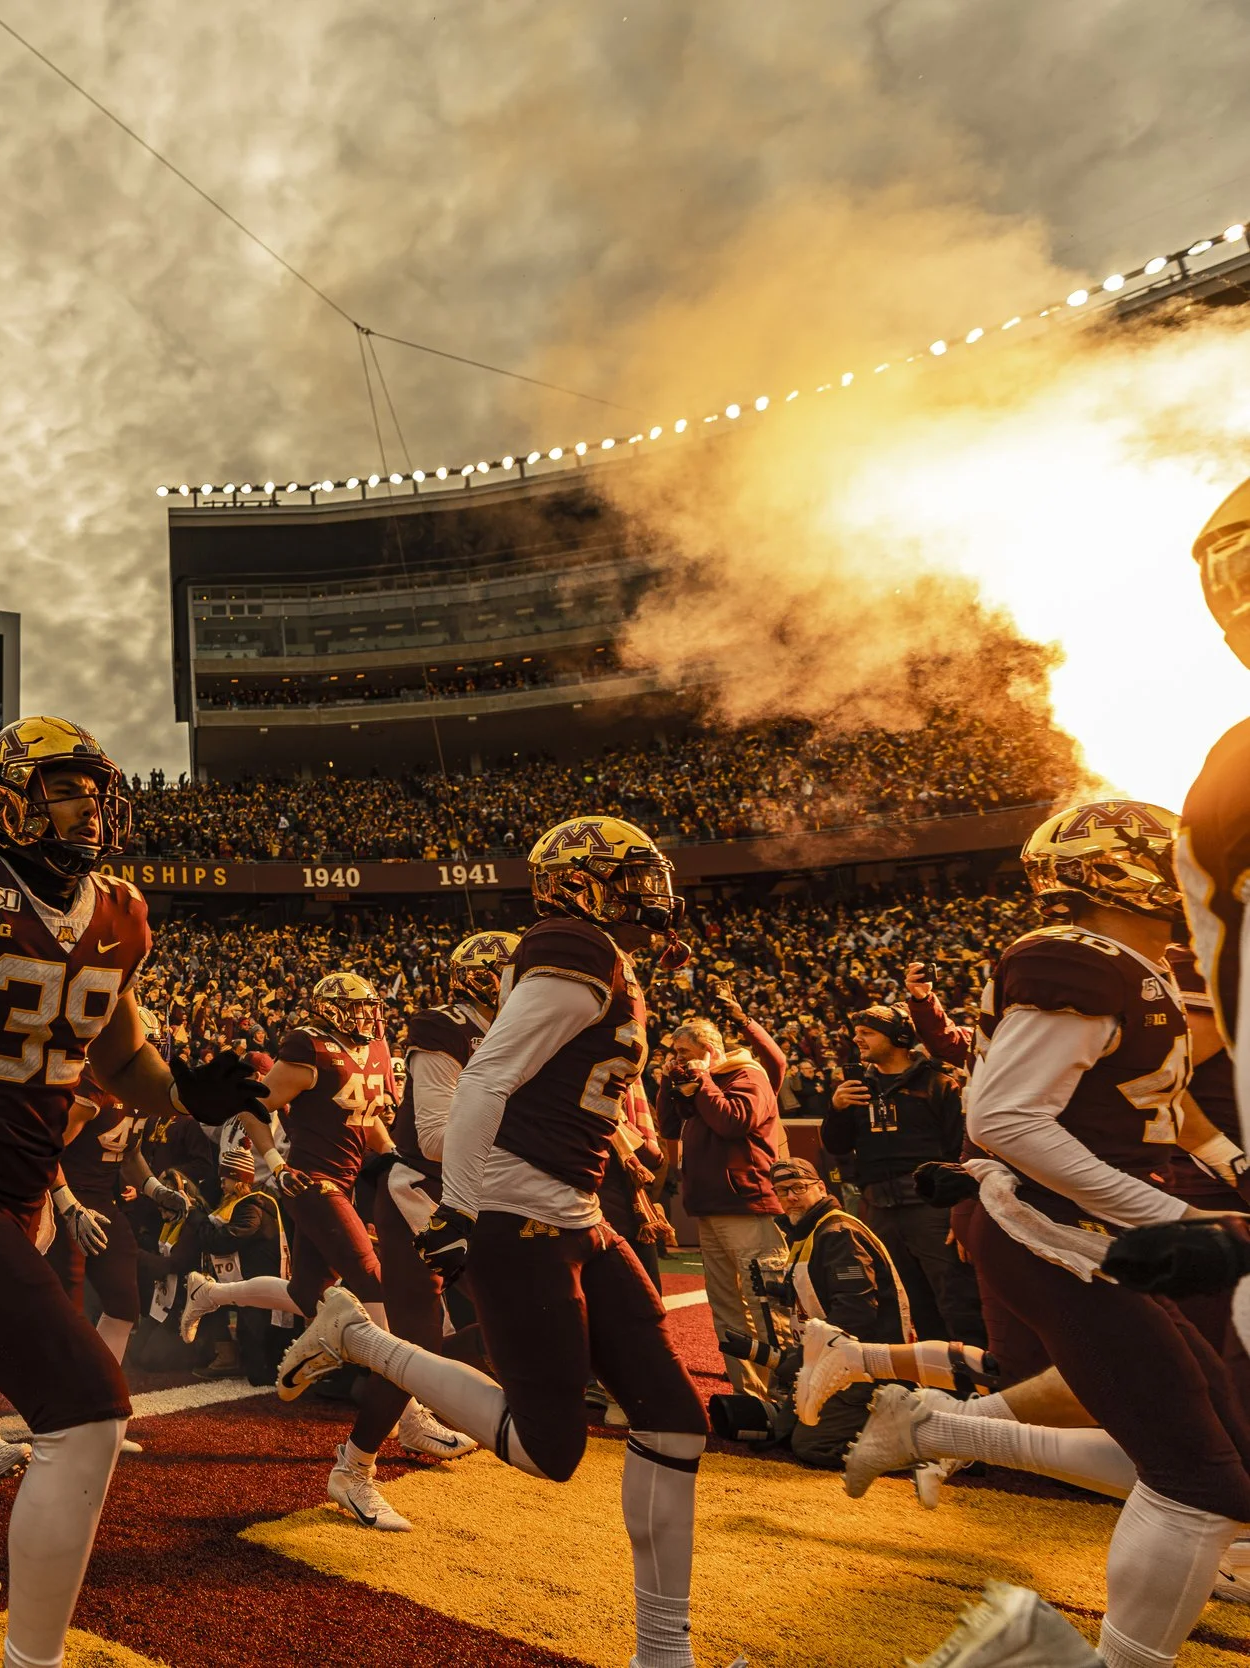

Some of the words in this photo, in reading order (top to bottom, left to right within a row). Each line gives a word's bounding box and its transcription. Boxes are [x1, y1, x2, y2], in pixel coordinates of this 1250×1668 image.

[303, 867, 361, 888] 1940
[438, 864, 499, 886] 1941
[331, 1072, 384, 1127] 42
